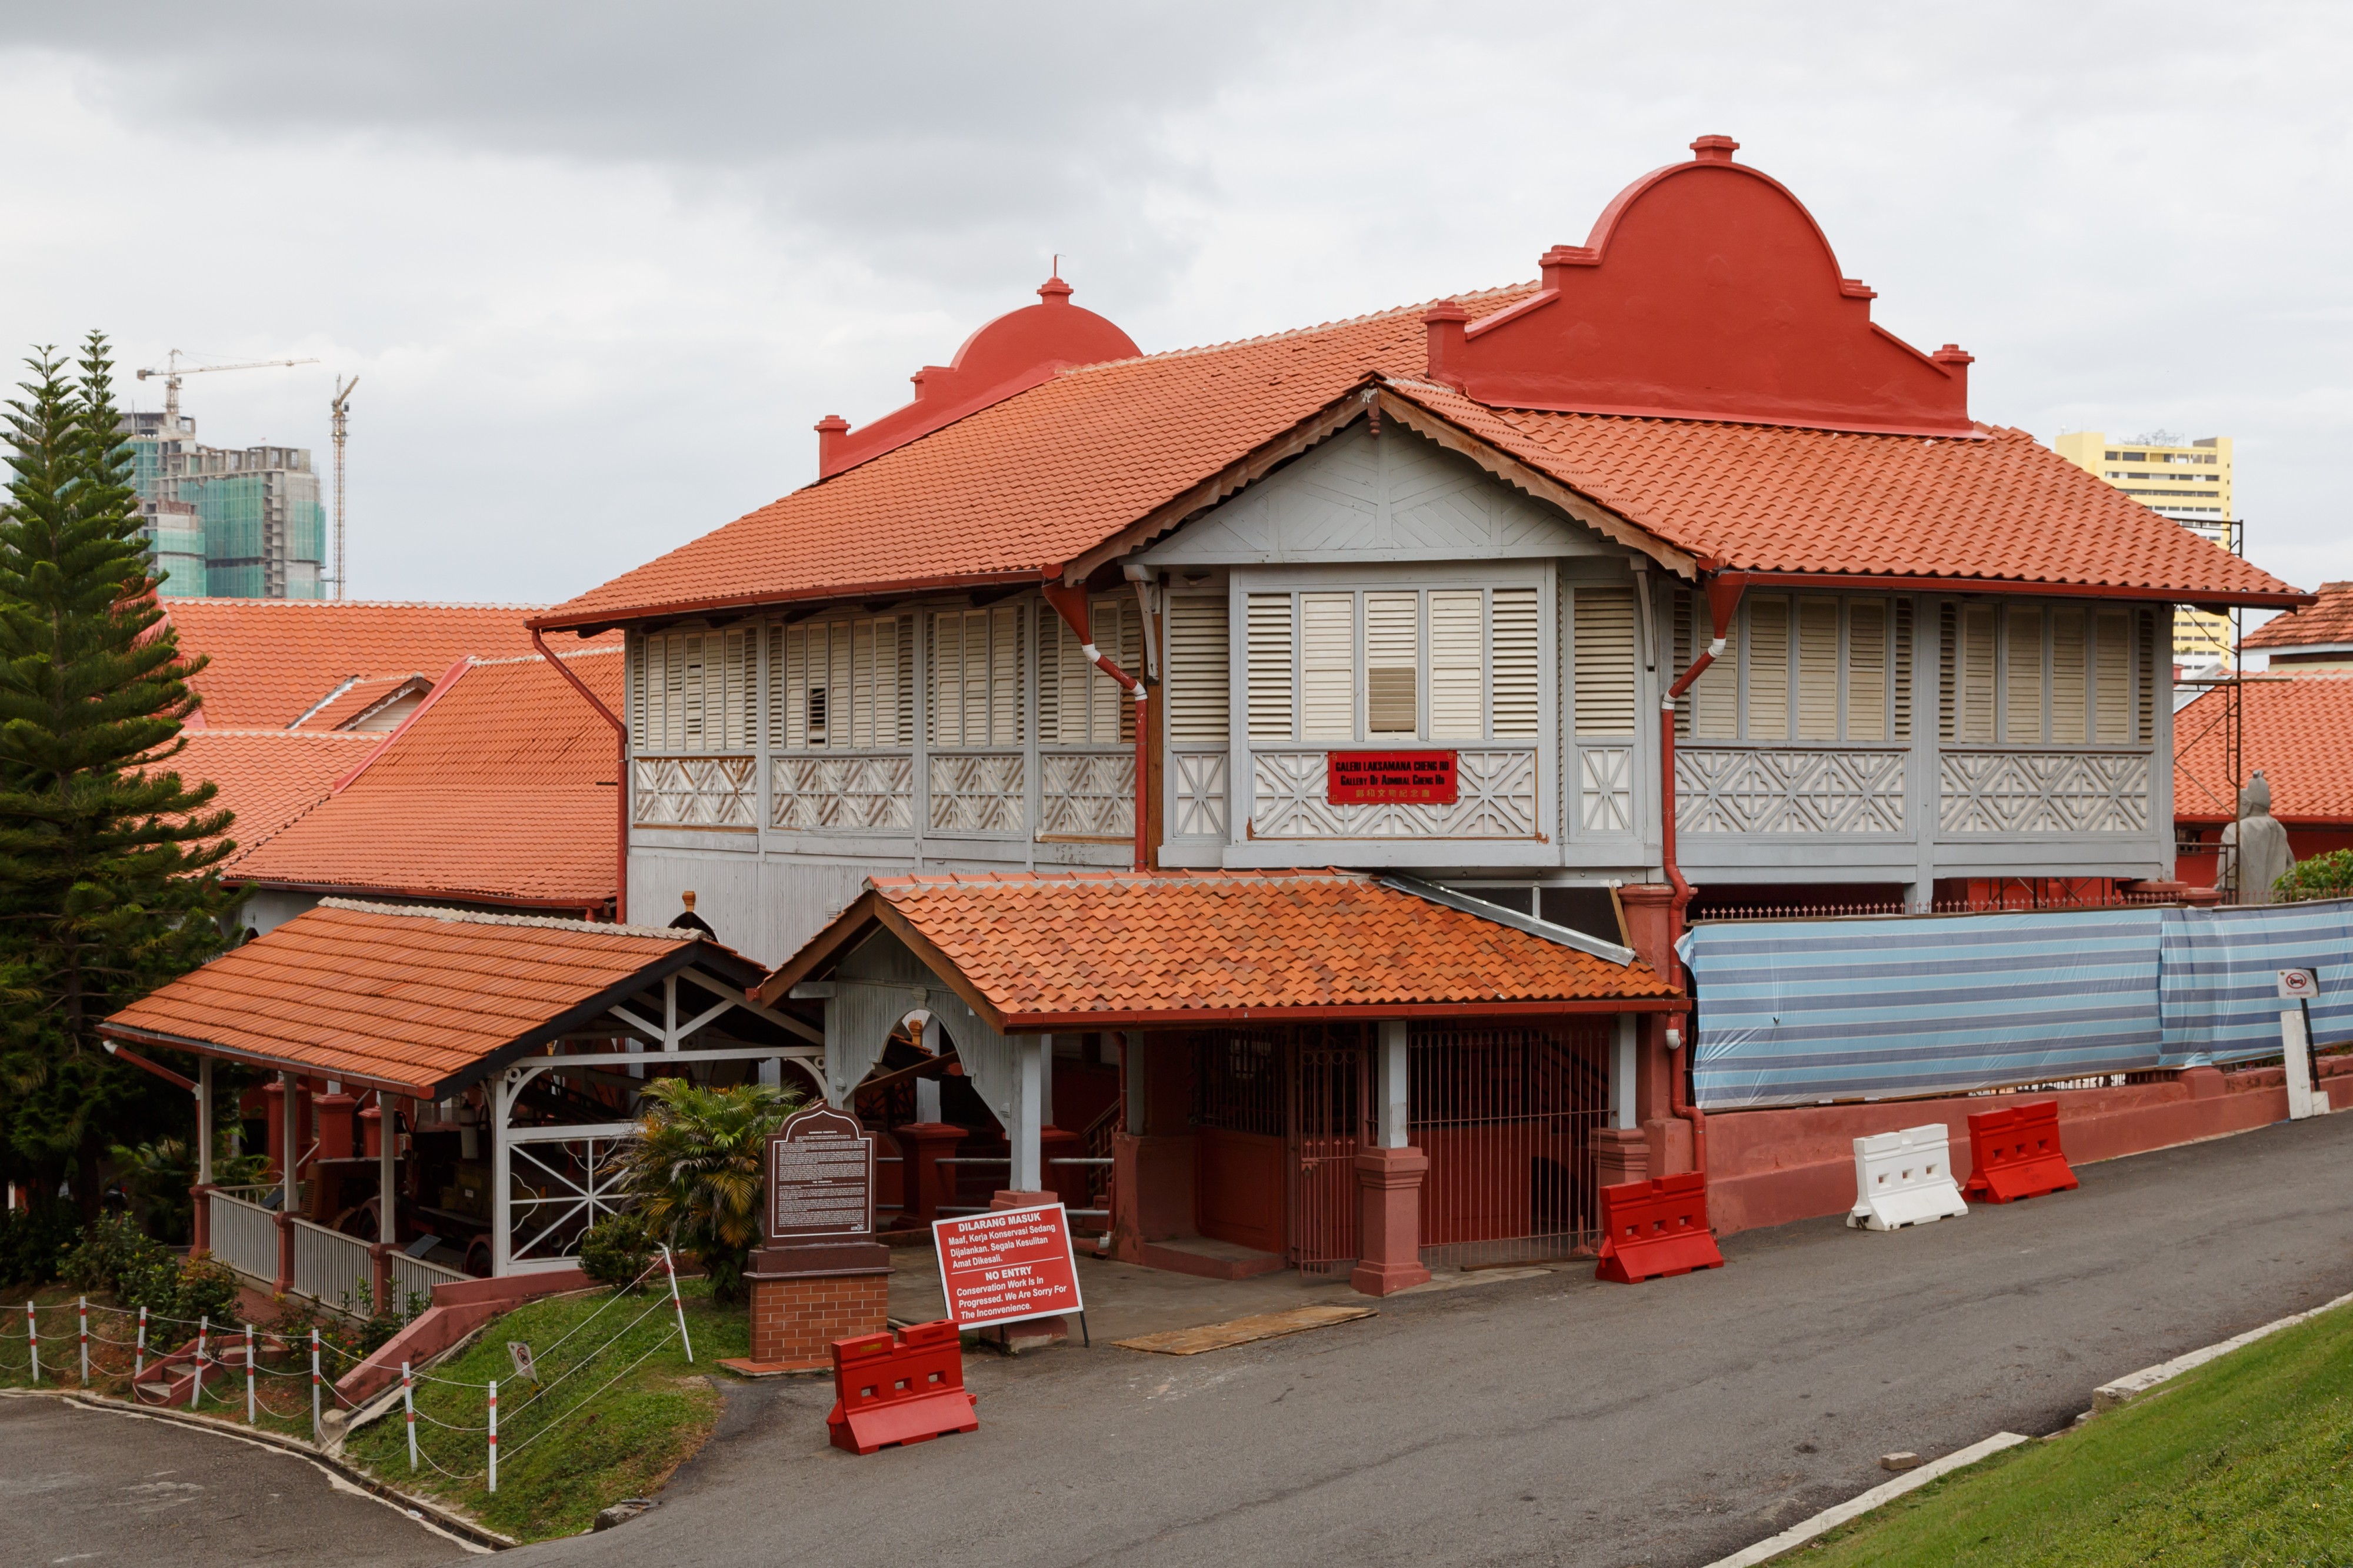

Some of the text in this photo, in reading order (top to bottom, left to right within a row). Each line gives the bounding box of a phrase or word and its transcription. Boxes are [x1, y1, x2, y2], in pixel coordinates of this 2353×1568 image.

[1336, 762, 1449, 771] GALERI LAKSAMANA CHENG HO
[958, 1213, 1041, 1232] DILARANG MASUK
[949, 1223, 1055, 1246] Maaf, Kerja Konservasi Sedang
[951, 1236, 1048, 1258] Dijalankan. Segala Kesulitan
[952, 1255, 1002, 1269] Amat Dikesali.
[985, 1266, 1032, 1281] NO ENTRY
[956, 1283, 1005, 1296] Conservation
[1008, 1279, 1026, 1287] Work
[959, 1285, 1066, 1308] Progressed. We Are Sorry For
[961, 1303, 1032, 1319] The Inconvenience.
